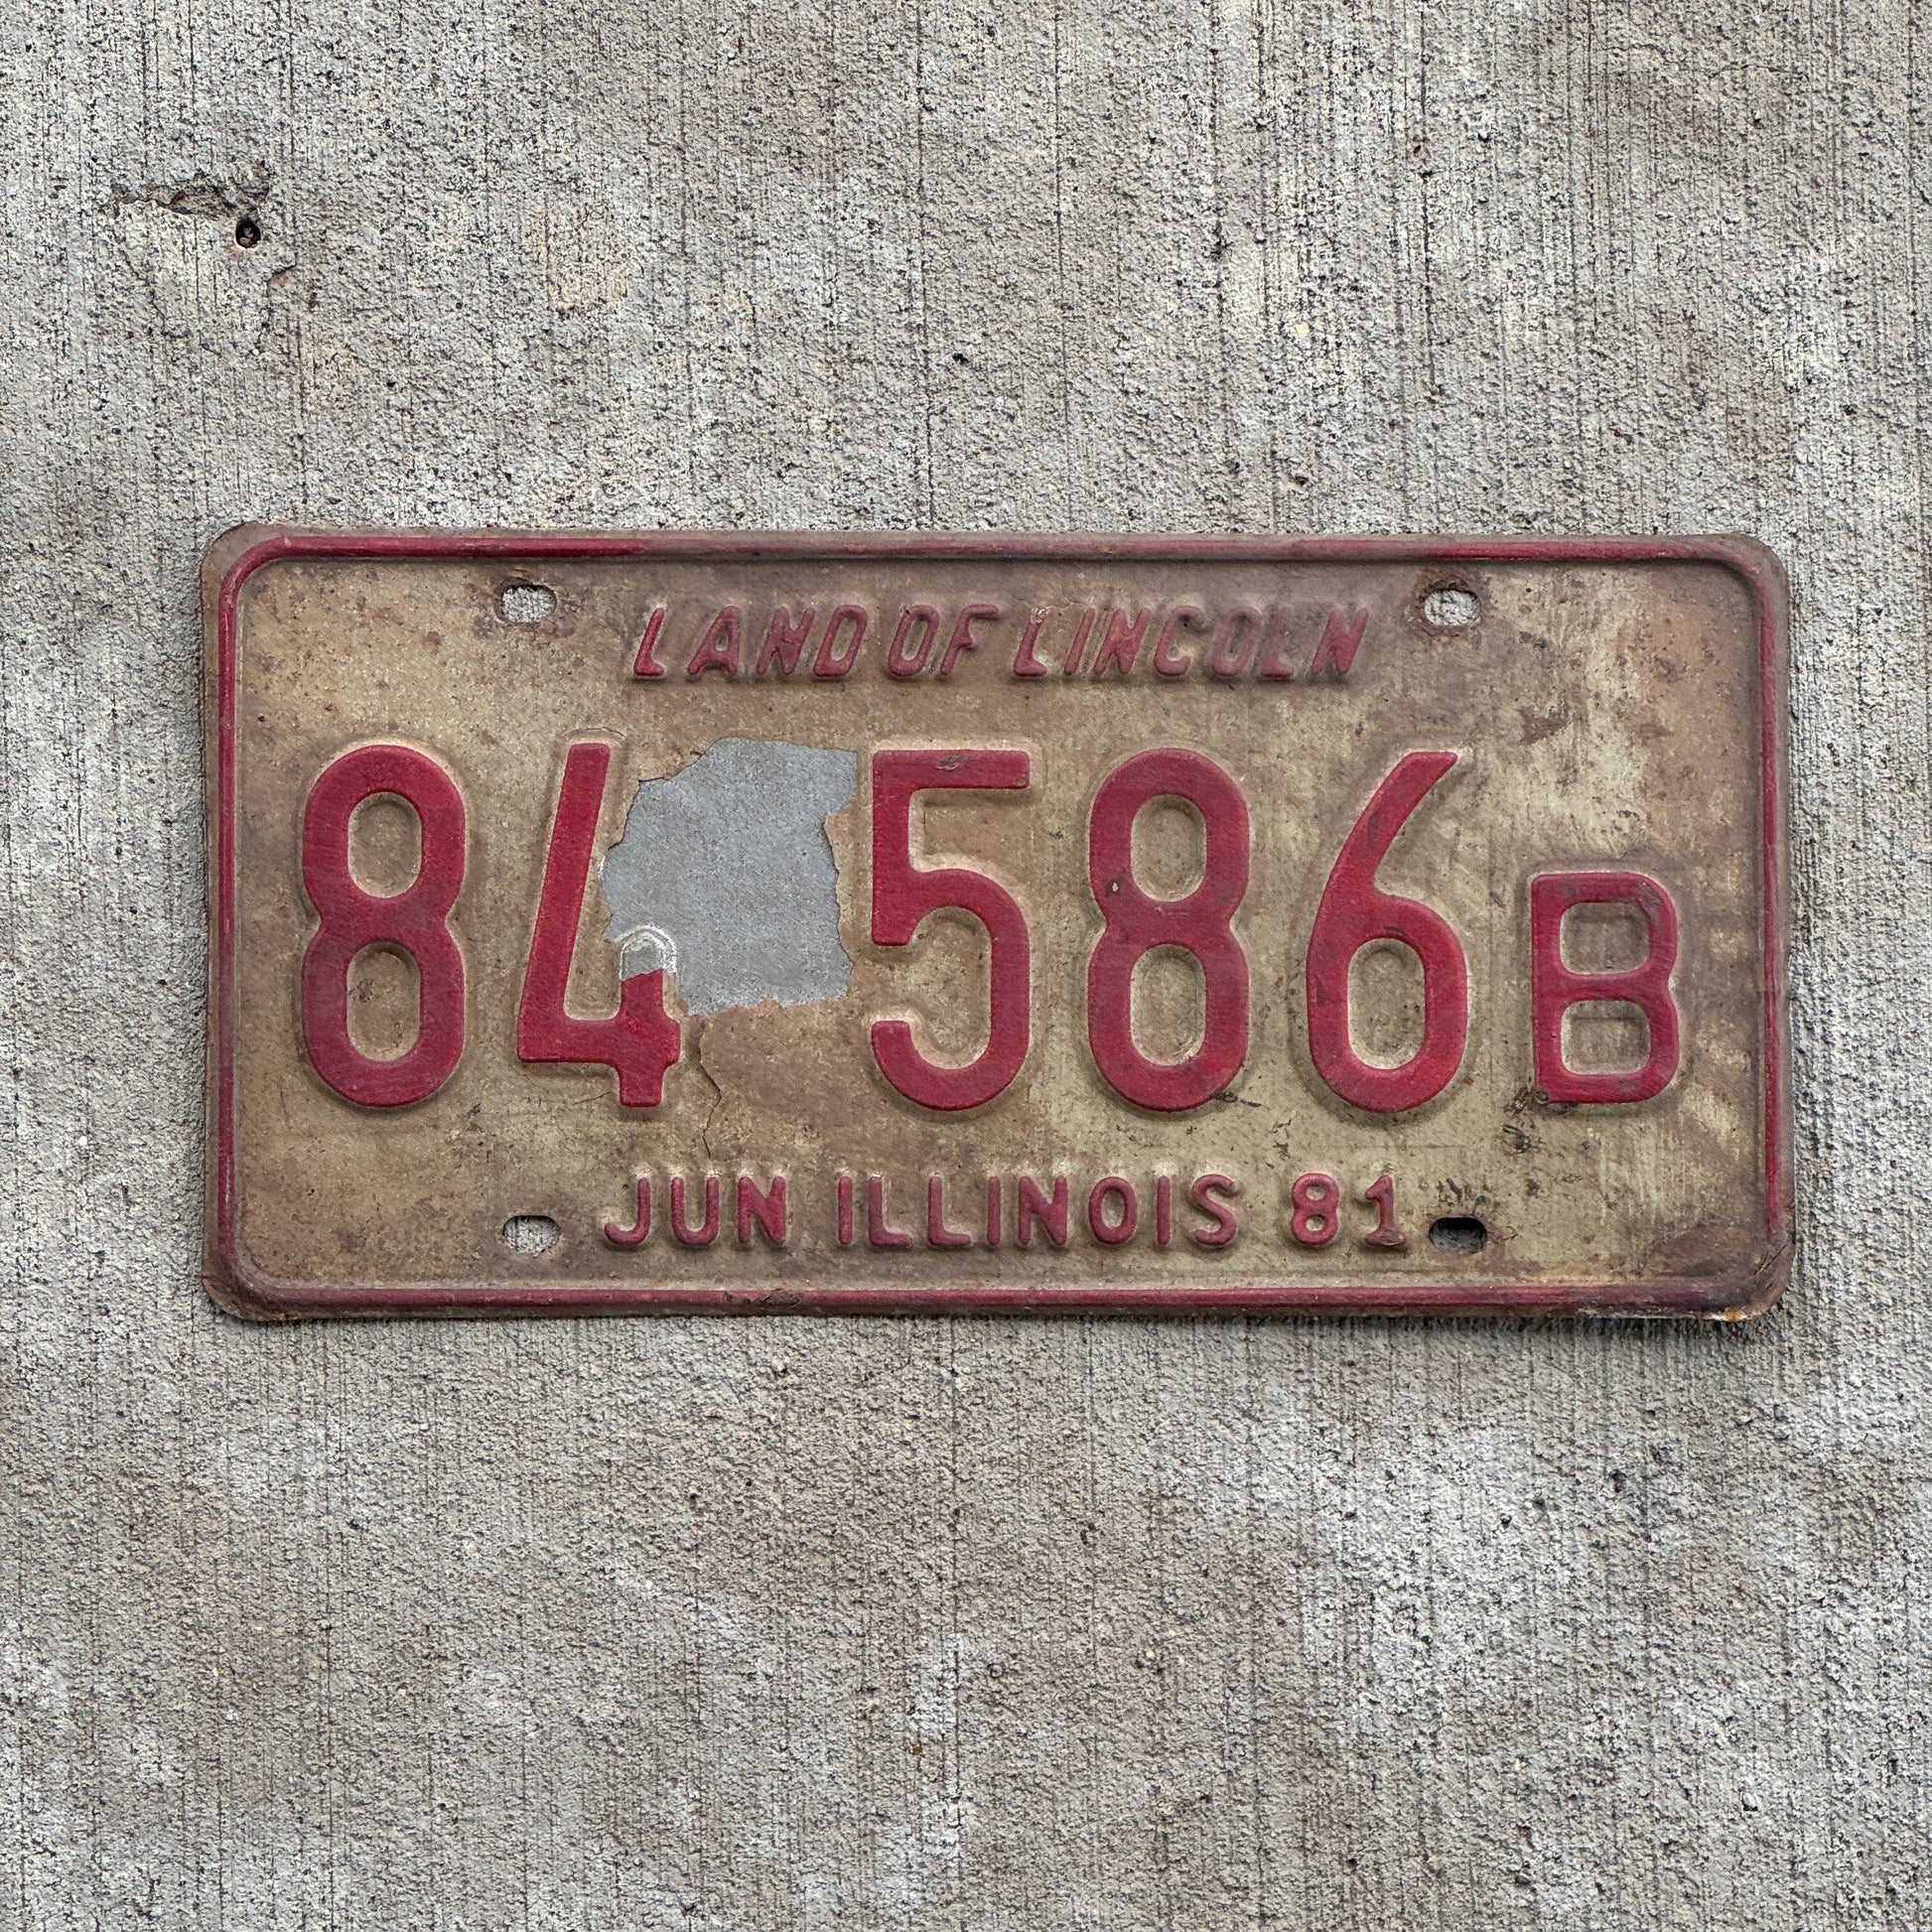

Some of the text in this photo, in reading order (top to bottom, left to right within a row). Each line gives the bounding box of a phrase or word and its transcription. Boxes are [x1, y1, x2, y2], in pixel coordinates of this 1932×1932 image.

[631, 603, 1369, 680] LAND OF LINCOLN
[604, 1172, 1409, 1249] JUN ILLINOIS 81
